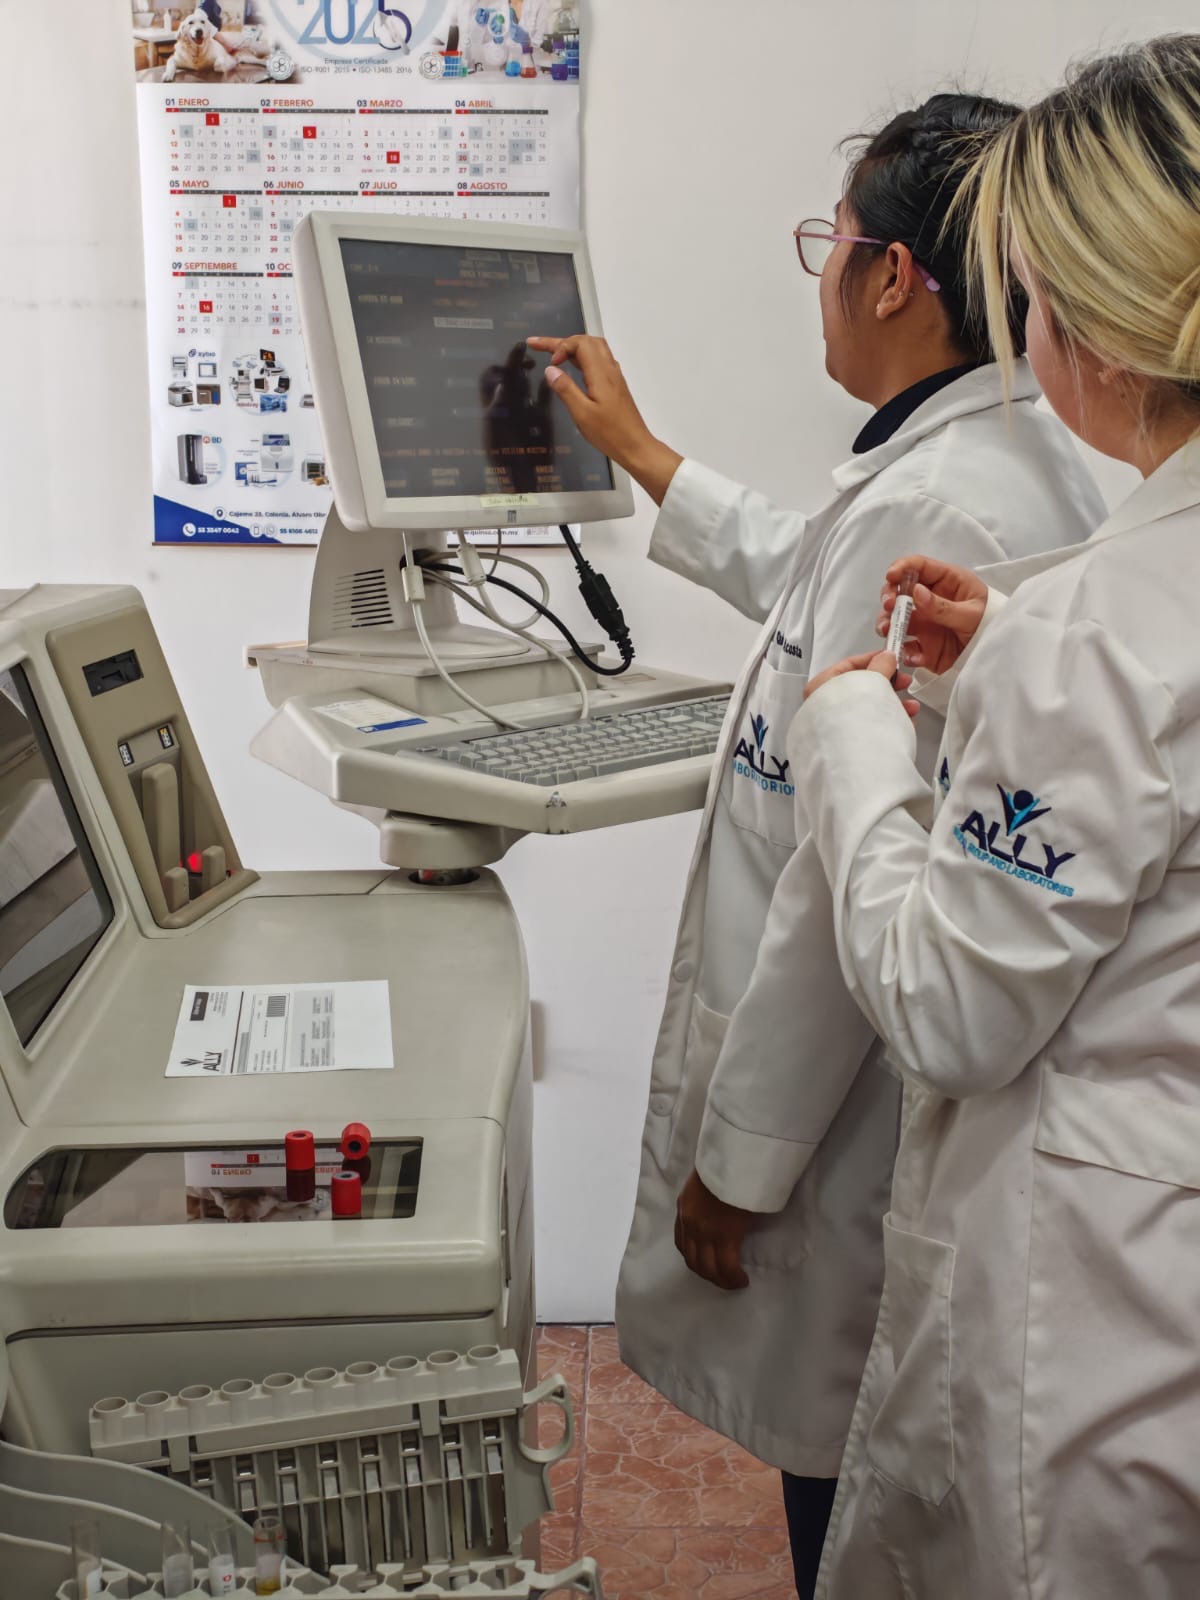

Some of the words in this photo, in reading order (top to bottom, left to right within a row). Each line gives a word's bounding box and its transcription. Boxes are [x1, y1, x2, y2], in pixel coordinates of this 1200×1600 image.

[165, 98, 175, 106] 01
[178, 98, 209, 106] ENERO
[260, 99, 271, 107] 02
[273, 99, 314, 107] FEBRERO
[356, 99, 367, 107] 03
[468, 100, 493, 108] ABRIL
[169, 180, 180, 188] 05
[182, 180, 209, 188] MAYO
[263, 180, 274, 188] 06
[277, 181, 304, 189] JUNIO
[360, 181, 370, 189] 07
[457, 182, 468, 190] 08
[470, 182, 507, 190] AGOSTO
[184, 262, 238, 270] SEPTIEMBRE
[211, 436, 222, 444] BD
[733, 737, 790, 783] ALLY
[959, 810, 1077, 879] ALLY
[1006, 864, 1075, 897] LABORATORIES
[202, 1050, 222, 1072] ALLY
